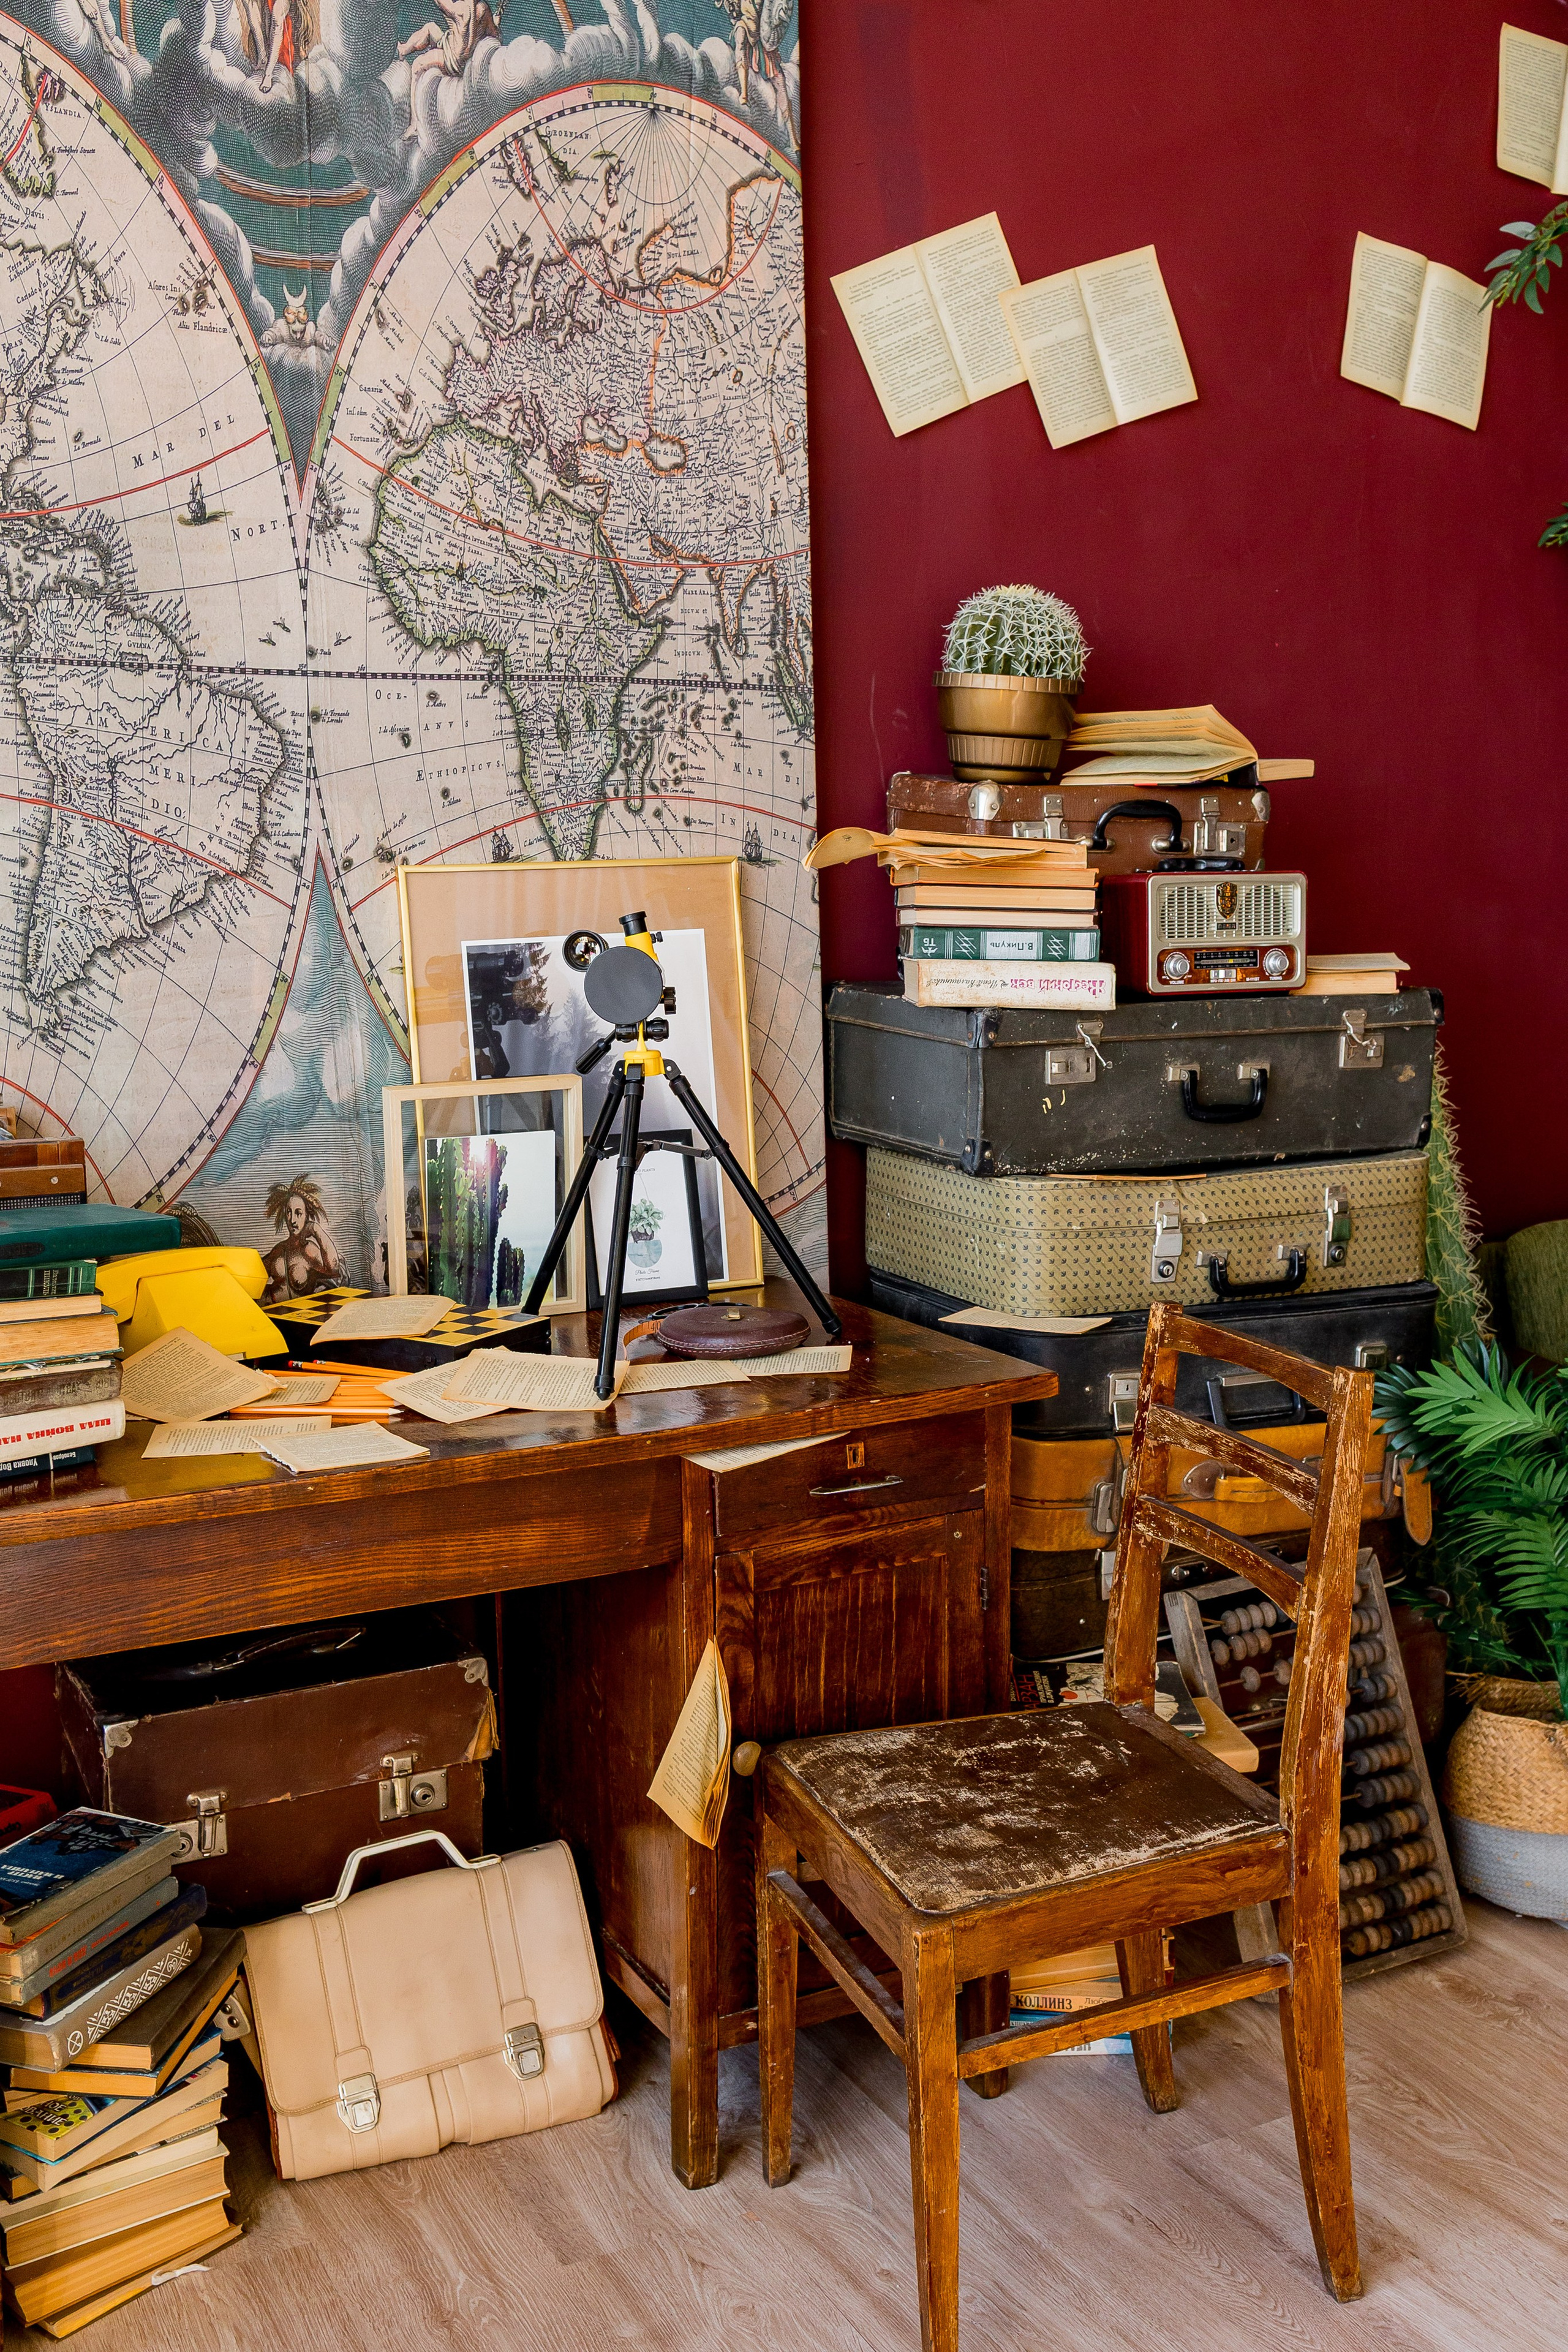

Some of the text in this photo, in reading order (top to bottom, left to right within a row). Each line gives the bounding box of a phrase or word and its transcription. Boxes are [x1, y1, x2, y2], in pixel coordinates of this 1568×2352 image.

[413, 209, 423, 218] 50
[254, 361, 260, 372] 30
[334, 368, 343, 377] 30
[1011, 979, 1106, 998] Жестокий век
[26, 1425, 74, 1440] ВОЙНА
[1016, 1994, 1072, 2010] КОЛЛИНЗ
